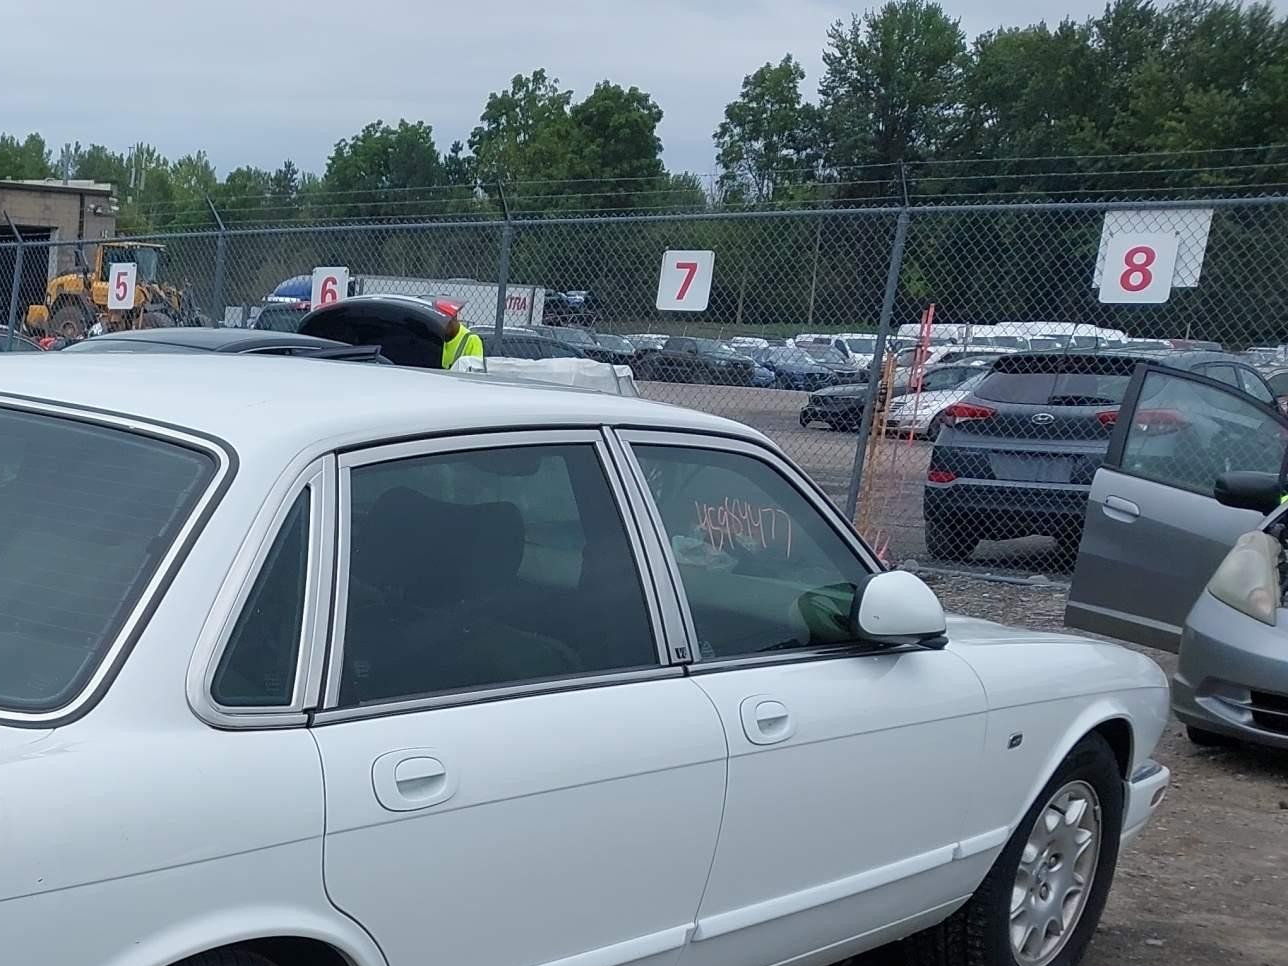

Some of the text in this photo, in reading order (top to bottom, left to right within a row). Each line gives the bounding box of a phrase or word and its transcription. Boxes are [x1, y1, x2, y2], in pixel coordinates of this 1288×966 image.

[115, 271, 128, 301] 5
[676, 262, 698, 300] 7
[1120, 246, 1156, 292] 8
[321, 276, 337, 304] 6
